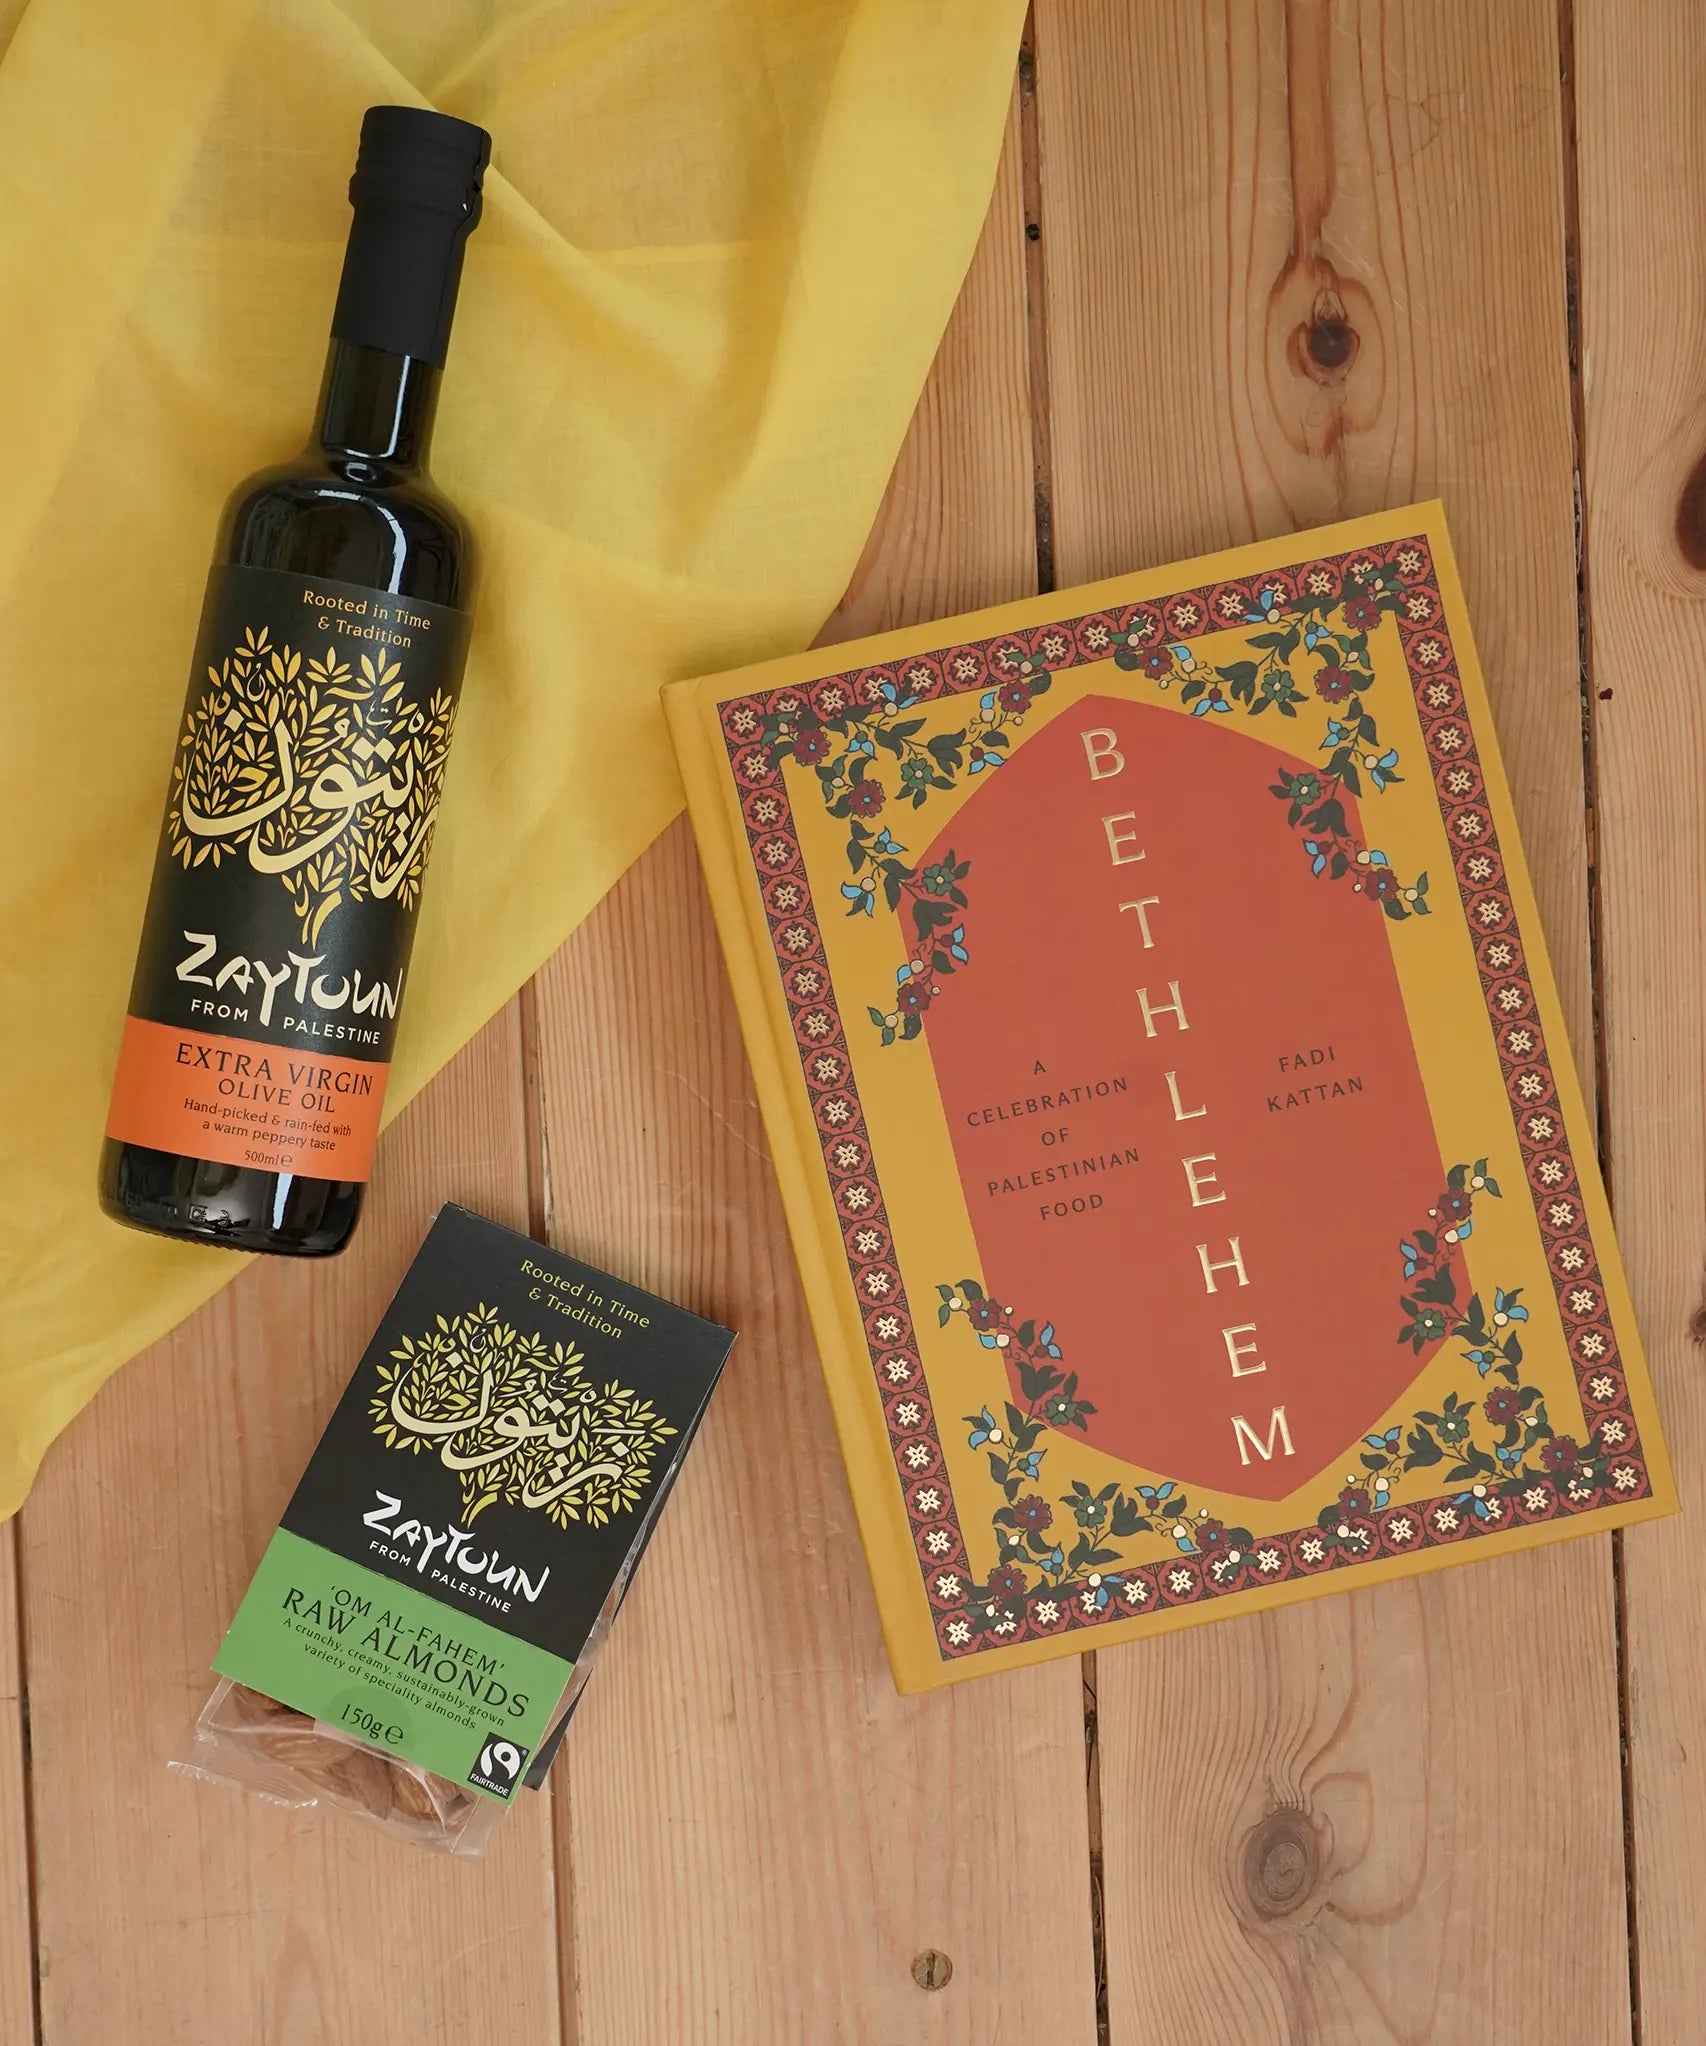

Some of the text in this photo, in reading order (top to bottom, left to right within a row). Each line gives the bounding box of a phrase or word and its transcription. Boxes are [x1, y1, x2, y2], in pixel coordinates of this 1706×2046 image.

[303, 590, 431, 630] Rooted in Time
[318, 616, 411, 648] & Tradition
[175, 930, 403, 1027] ZAYTOUN
[191, 999, 381, 1045] FROM PALESTINE
[176, 1042, 373, 1096] EXTRA VIRGIN
[1033, 1060, 1047, 1076] A
[1278, 1046, 1337, 1073] FADI
[184, 1098, 351, 1137] Hand-picked & rain-fed with
[218, 1078, 335, 1113] OLIVE OIL
[966, 1077, 1129, 1127] CELEBRATION
[1080, 727, 1296, 1466] BETHLEHEM
[1266, 1076, 1364, 1113] KATTAN
[202, 1120, 336, 1151] a warm peppery taste
[1041, 1127, 1070, 1146] OF
[988, 1148, 1140, 1196] PALESTINIAN
[1040, 1194, 1104, 1221] FOOD
[520, 1259, 651, 1329] Rooted in Time
[528, 1287, 623, 1339] & Tradition
[362, 1490, 549, 1602] ZAYTOUN
[368, 1540, 512, 1614] FROM PALESTINE
[282, 1587, 530, 1717] RAW ALMONDS
[283, 1617, 505, 1727] A crunchy, creamy, sustainably-grown
[304, 1643, 476, 1730] variety of speciality almonds
[470, 1773, 509, 1797] FAIRTRADE
